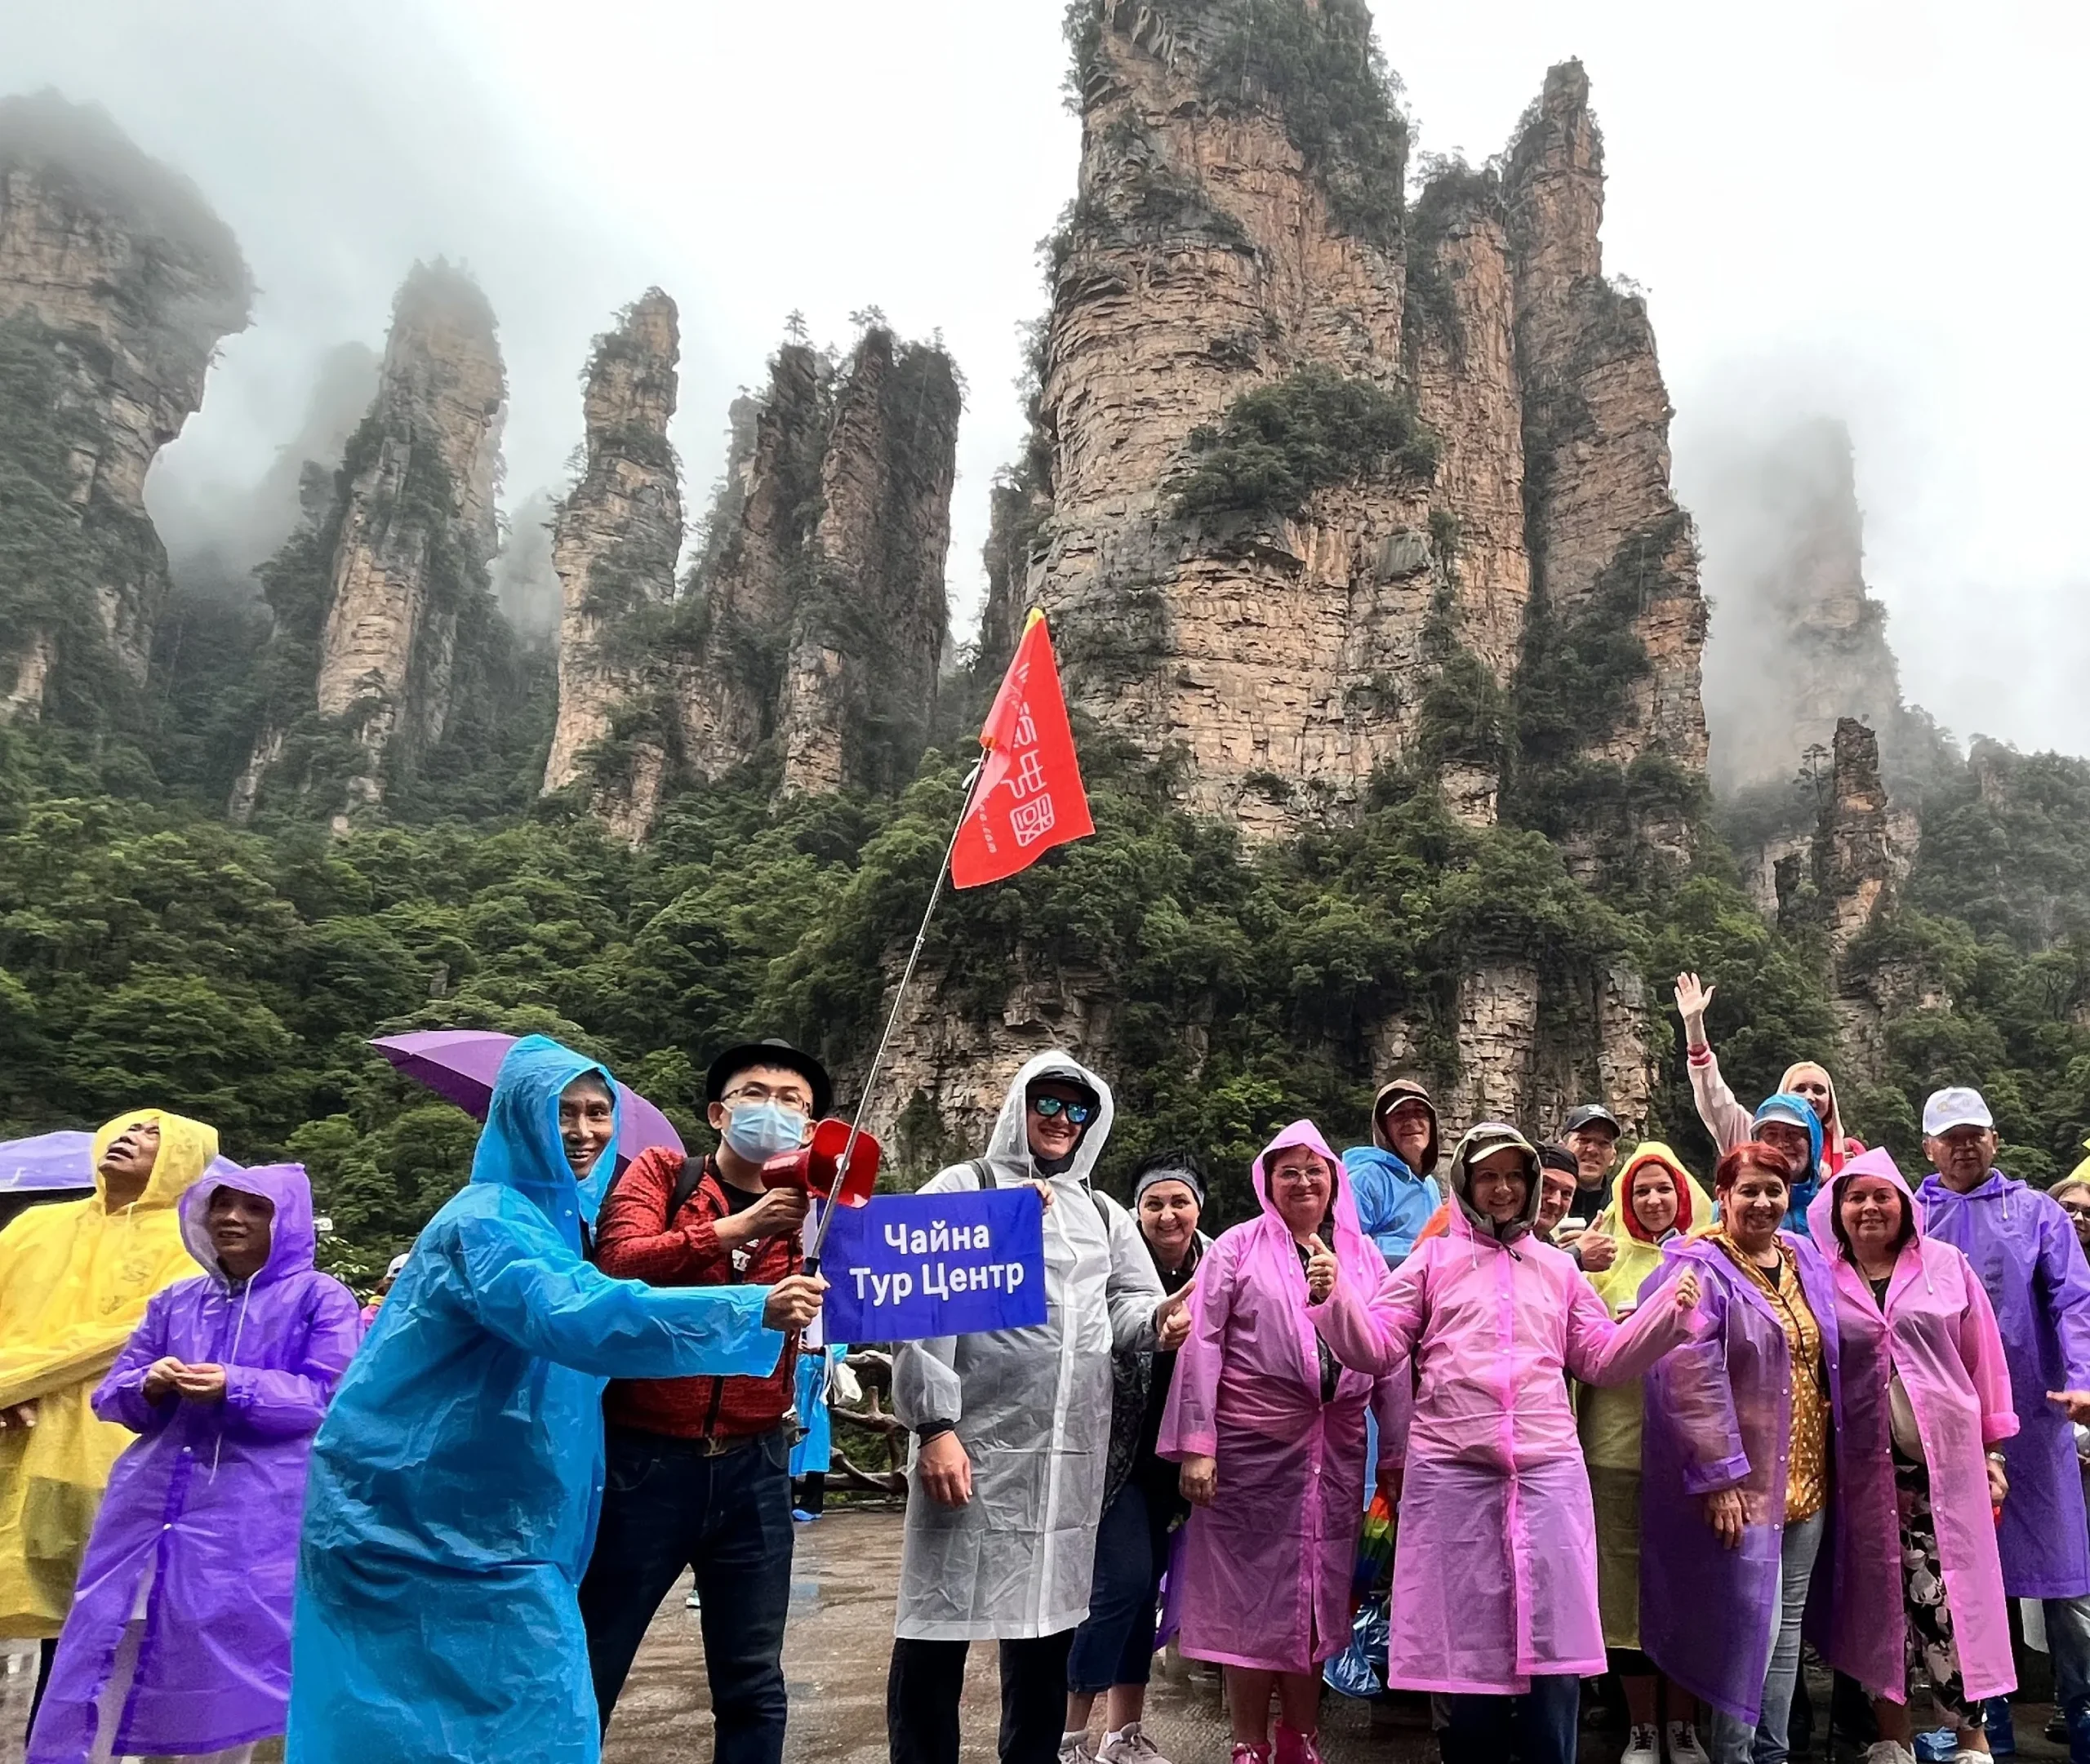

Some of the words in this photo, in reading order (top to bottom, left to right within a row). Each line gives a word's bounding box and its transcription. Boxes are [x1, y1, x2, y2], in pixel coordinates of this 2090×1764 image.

[884, 1220, 989, 1254] Чайна
[850, 1268, 913, 1306] Тур
[923, 1262, 1025, 1301] Центр
